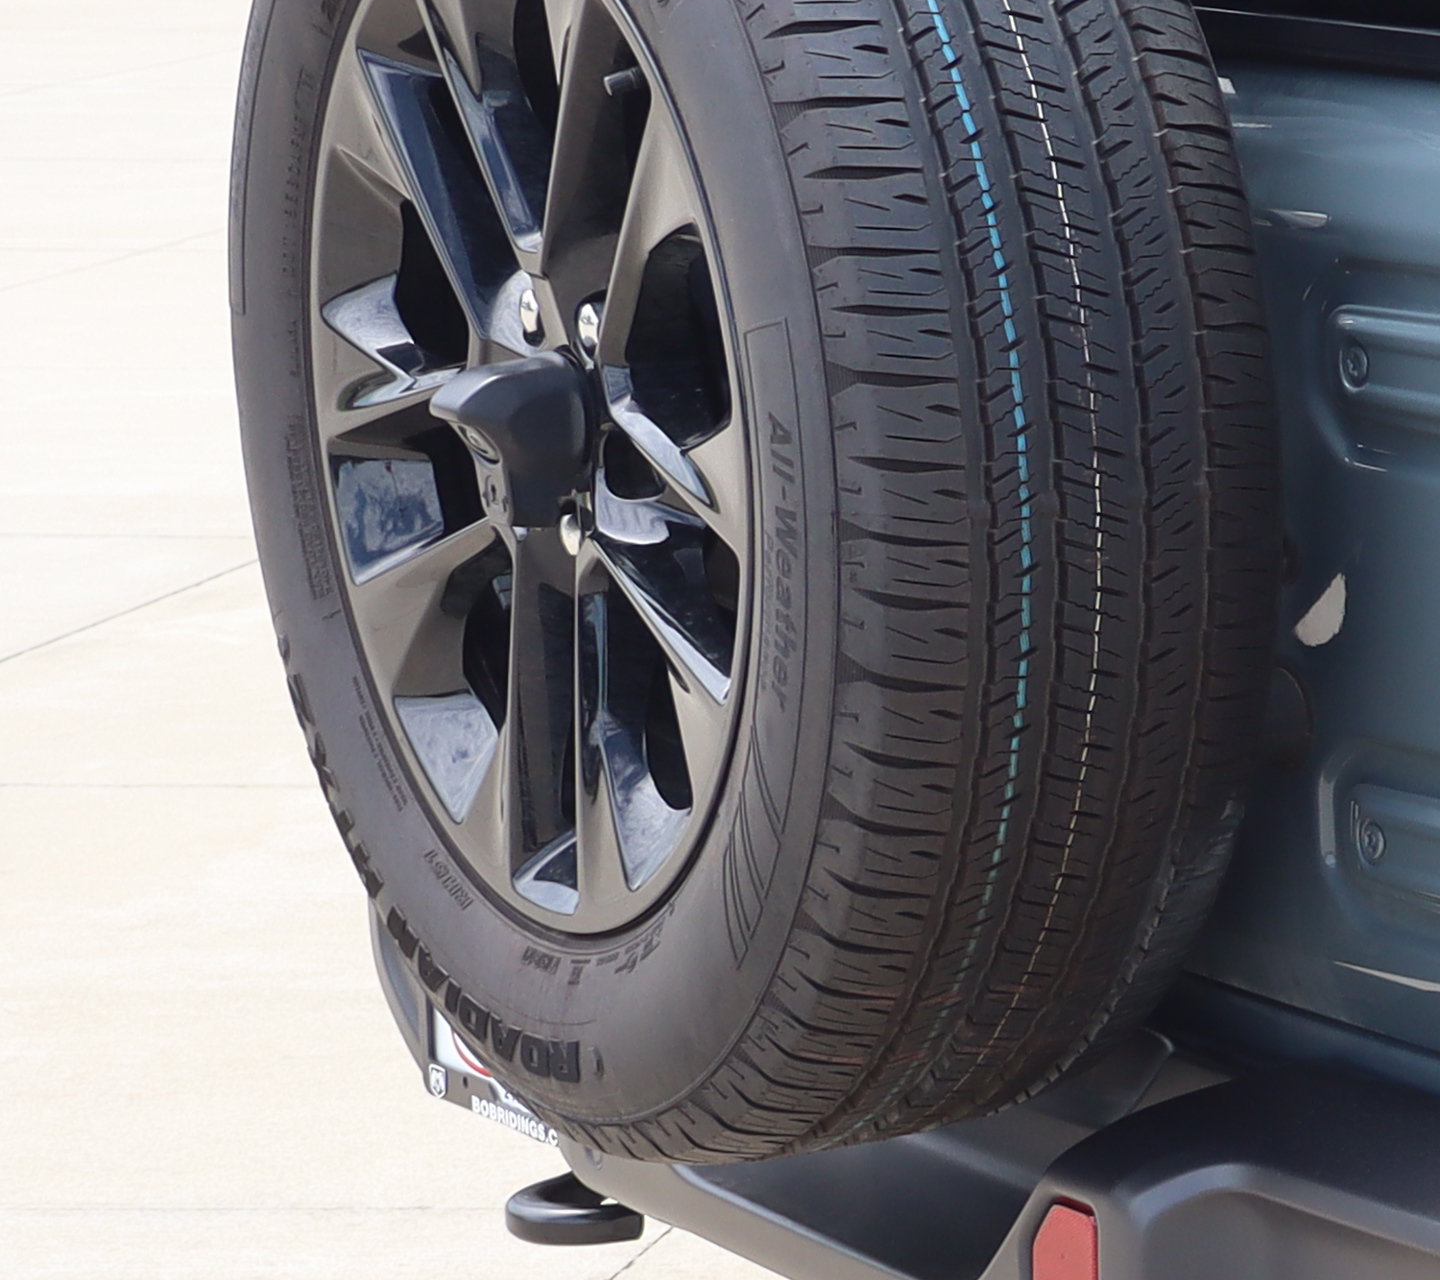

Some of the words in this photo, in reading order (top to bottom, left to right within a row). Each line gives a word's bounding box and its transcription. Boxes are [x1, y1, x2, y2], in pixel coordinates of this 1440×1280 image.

[768, 411, 800, 713] All-Weather
[387, 904, 581, 1084] ROADIAN
[471, 1093, 559, 1147] BOBRIDINGS.C
